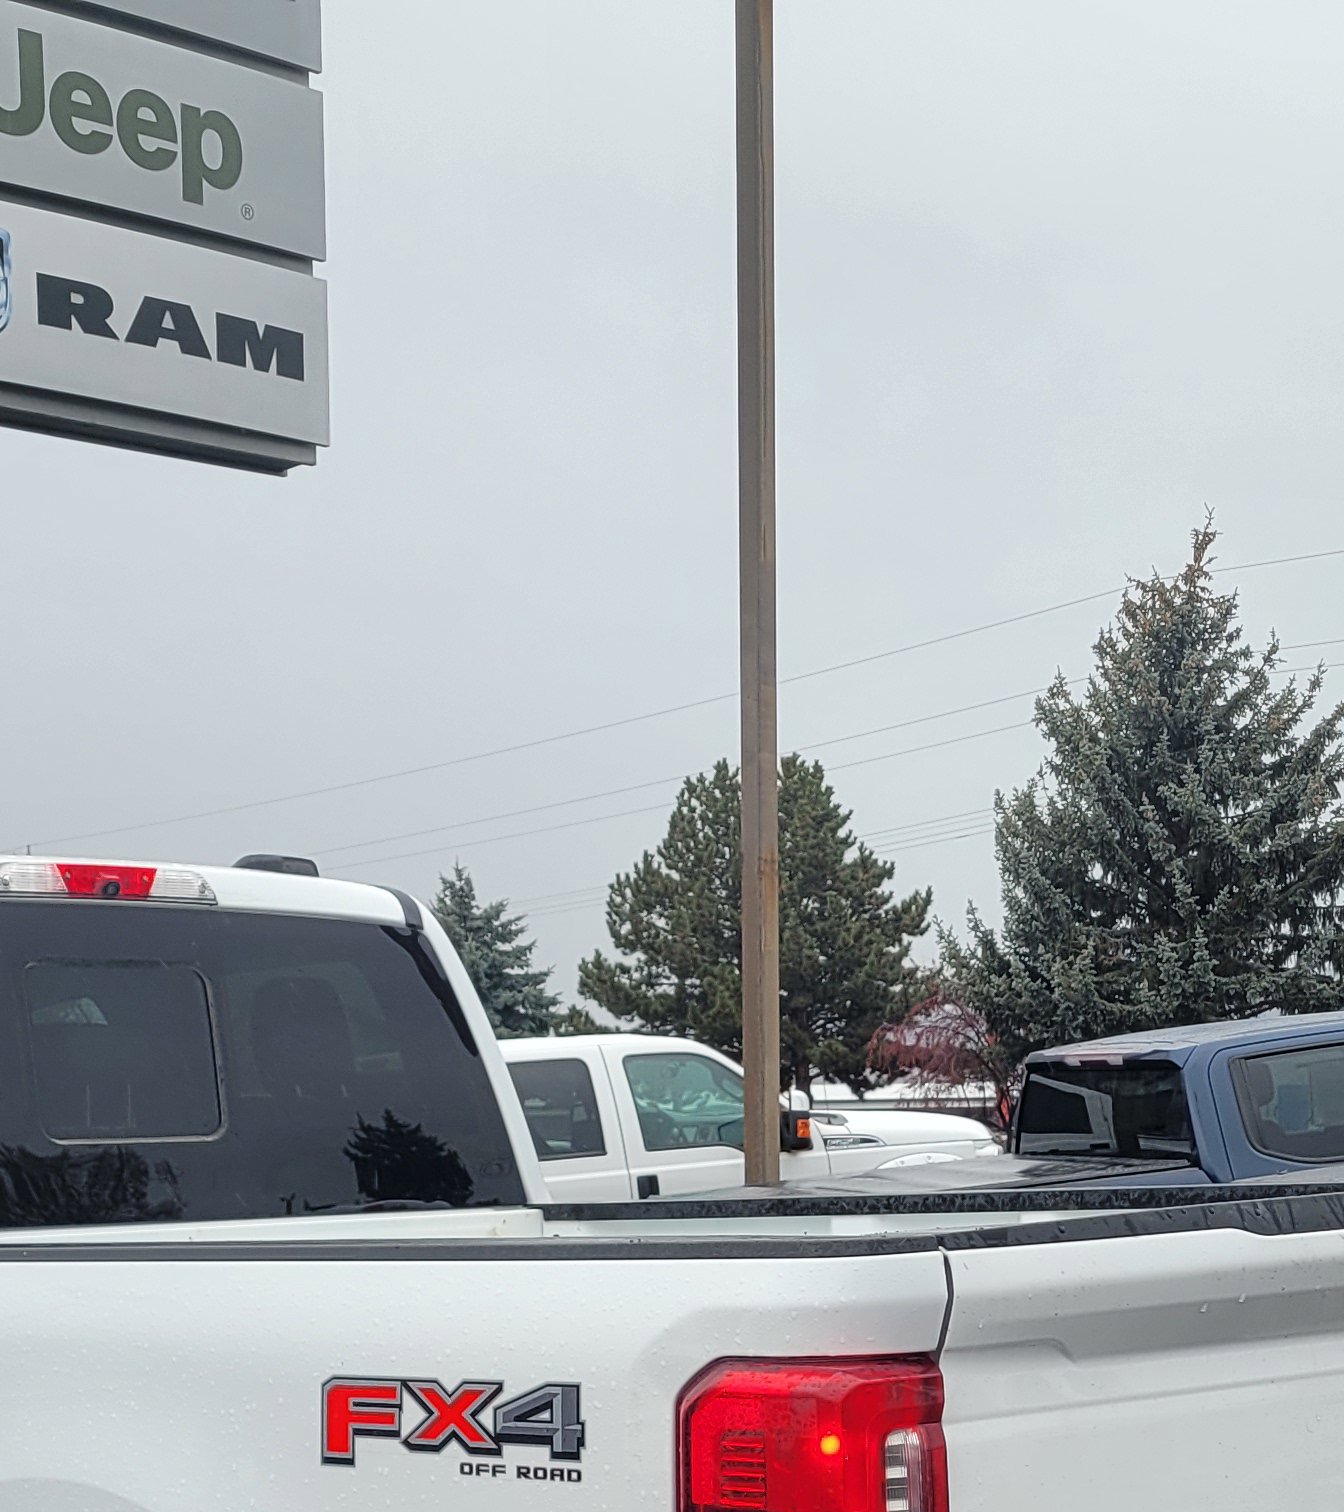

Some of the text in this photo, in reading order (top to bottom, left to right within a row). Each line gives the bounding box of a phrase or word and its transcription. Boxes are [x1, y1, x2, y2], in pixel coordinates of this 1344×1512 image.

[36, 273, 305, 382] RAM
[321, 1374, 586, 1467] FX4
[459, 1462, 582, 1483] OFF ROAD
